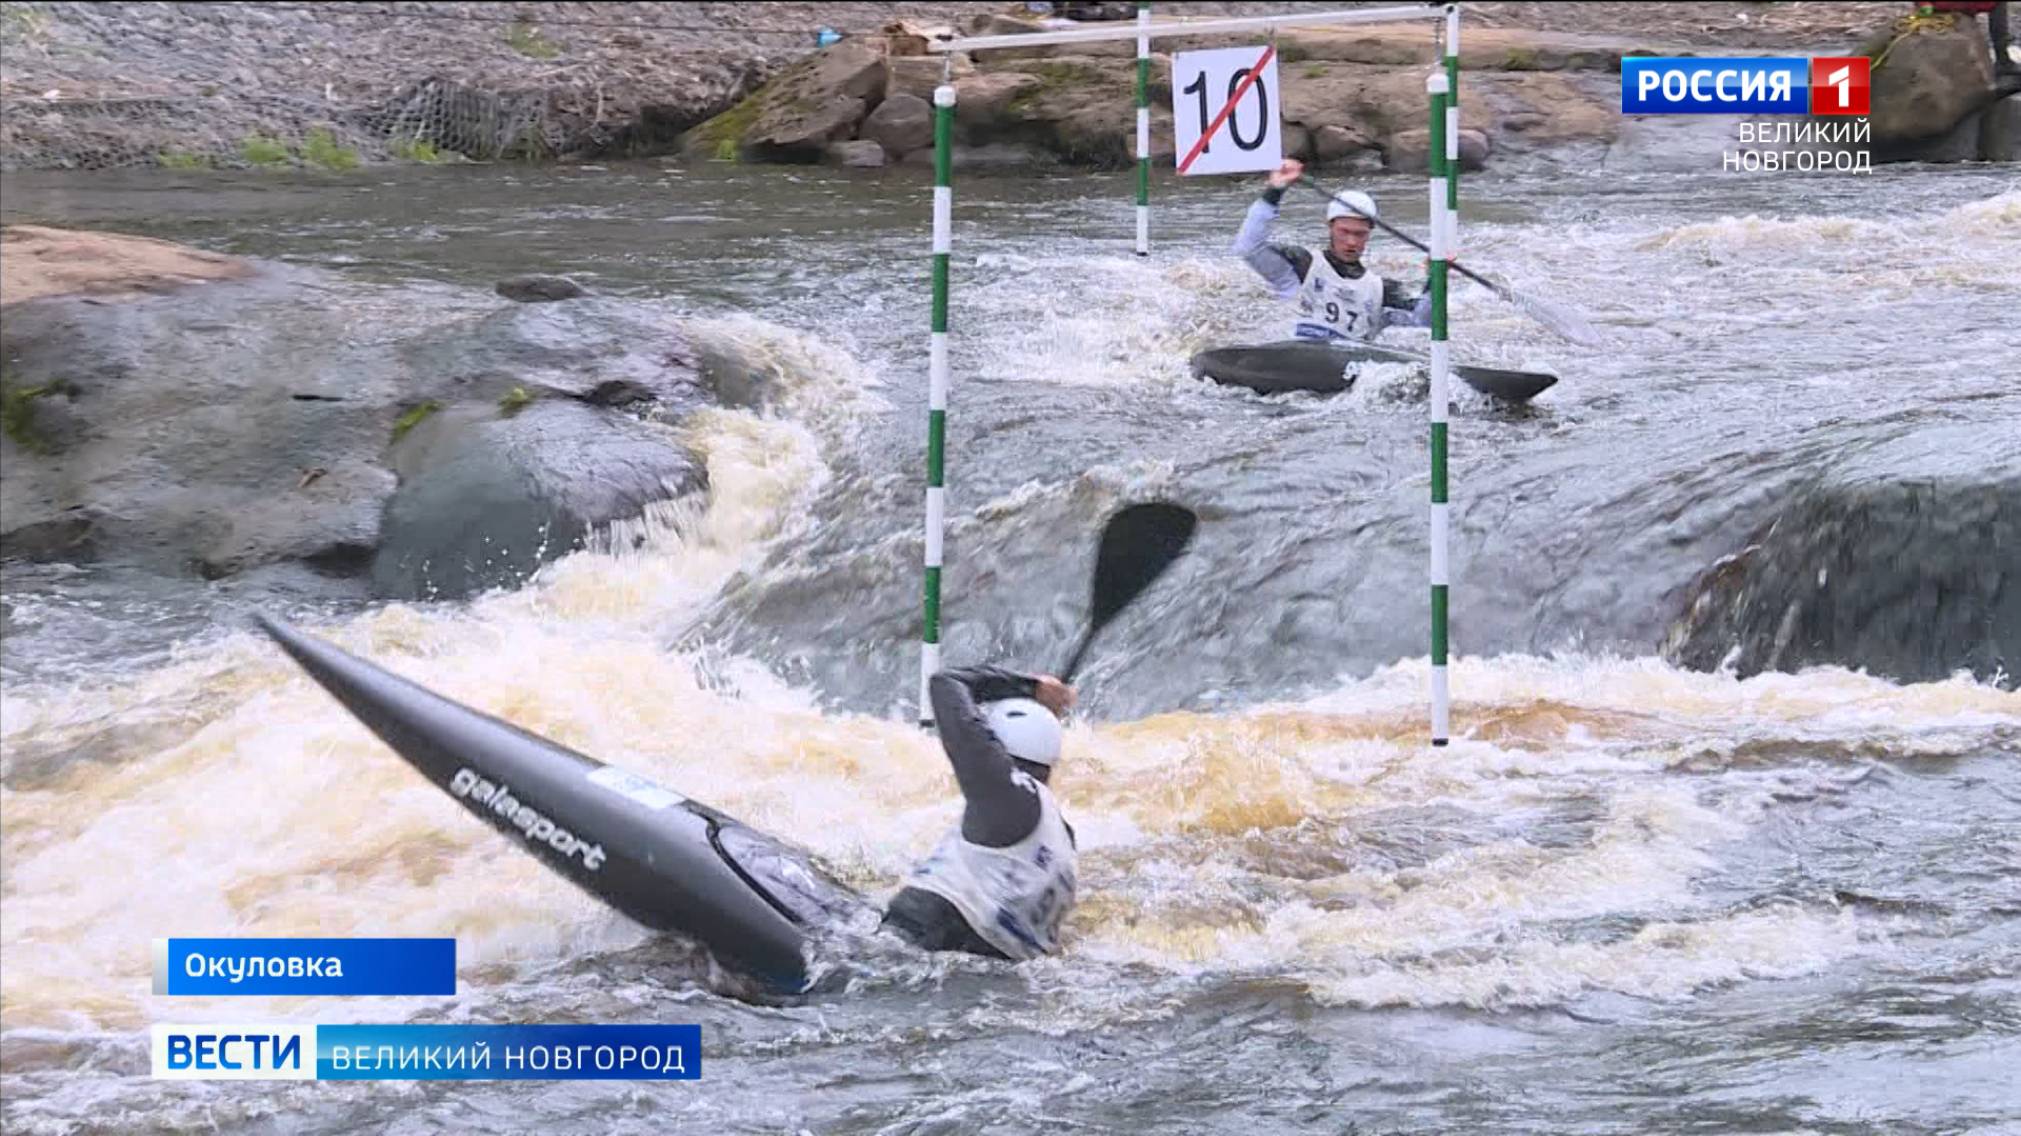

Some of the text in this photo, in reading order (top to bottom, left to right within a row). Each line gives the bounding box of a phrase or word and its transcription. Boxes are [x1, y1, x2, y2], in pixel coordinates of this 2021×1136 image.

[1183, 68, 1268, 154] 10
[1325, 302, 1358, 331] 97
[450, 767, 606, 870] galasport
